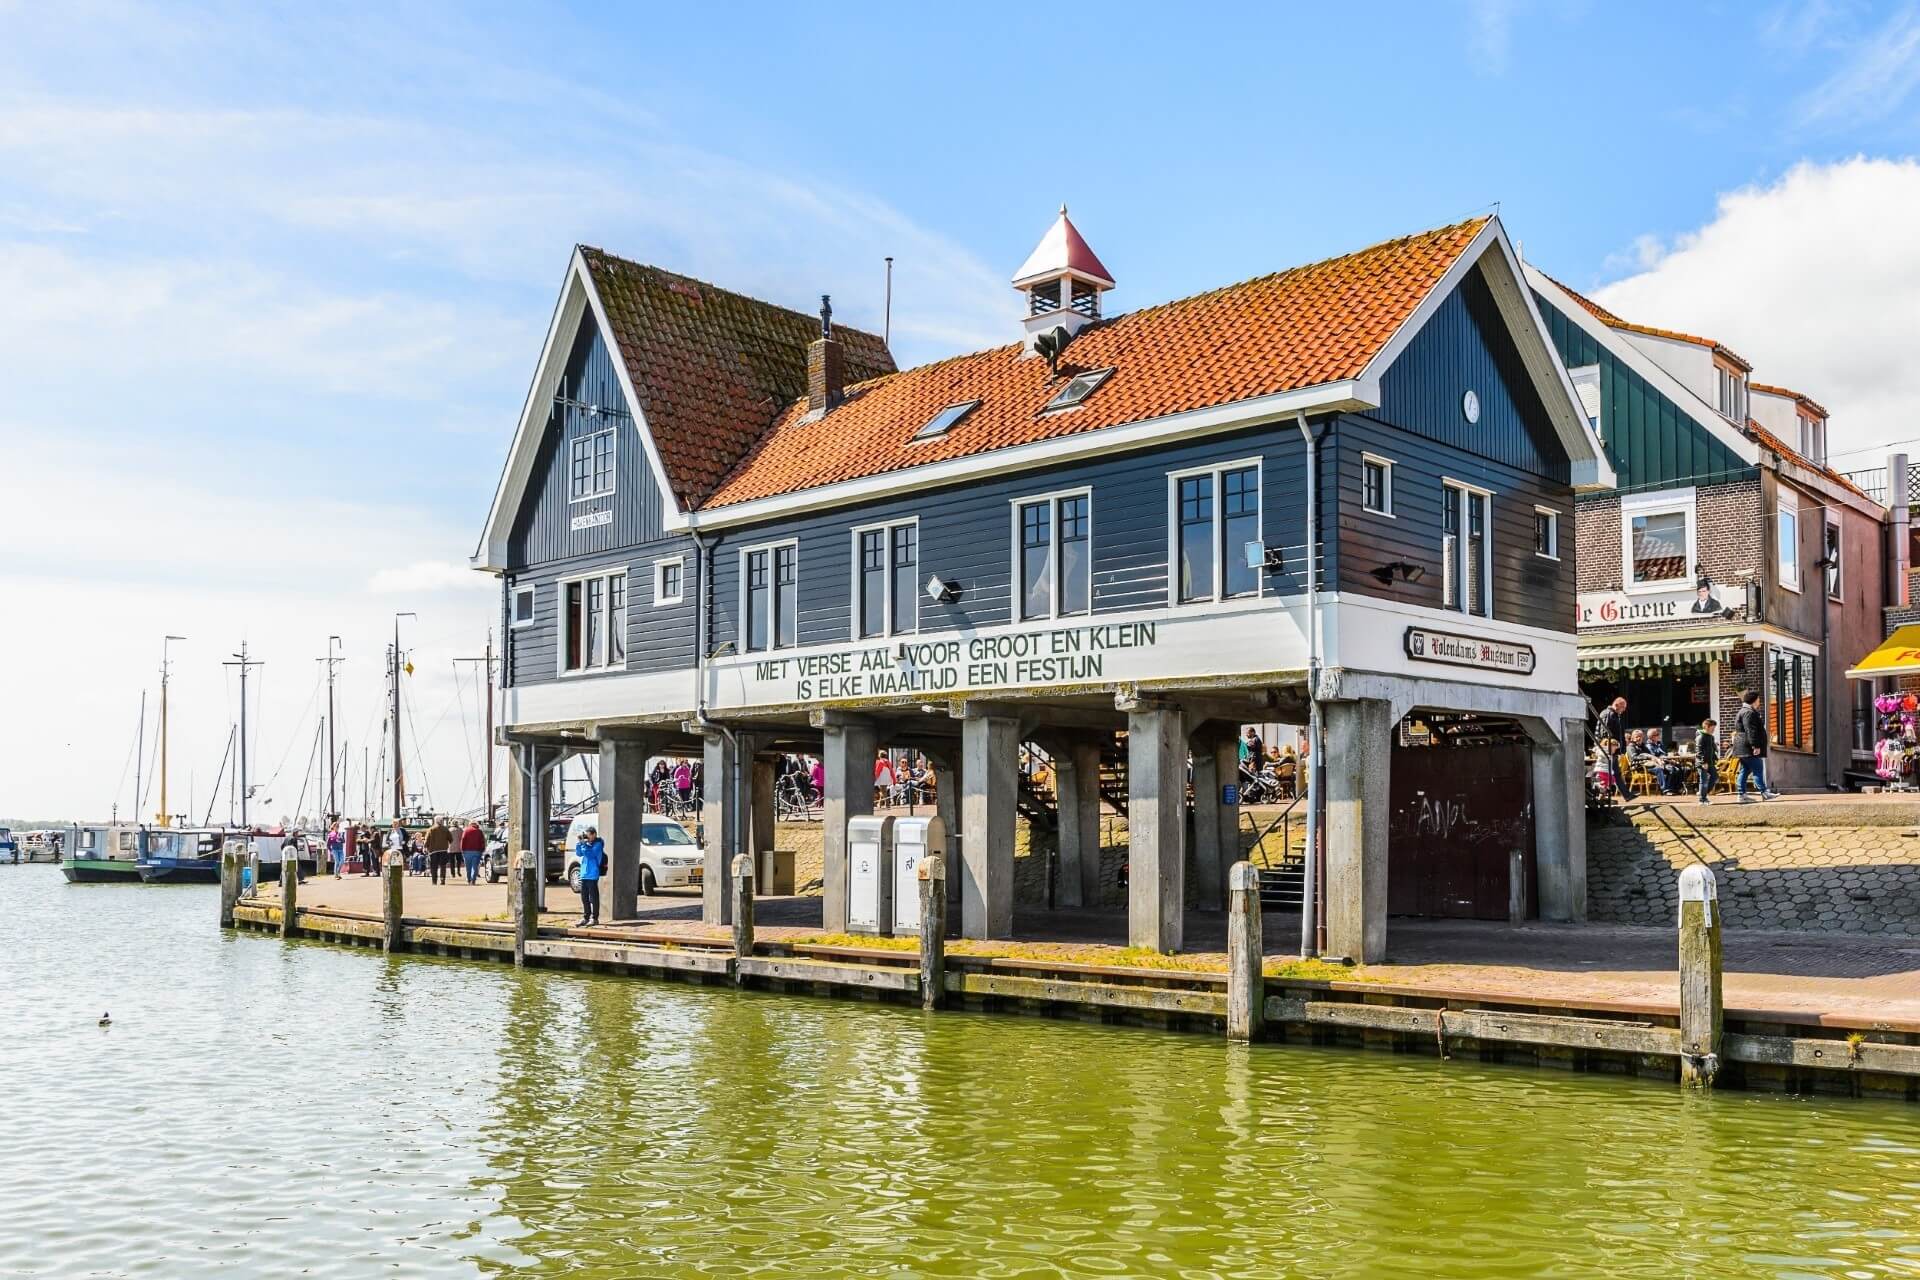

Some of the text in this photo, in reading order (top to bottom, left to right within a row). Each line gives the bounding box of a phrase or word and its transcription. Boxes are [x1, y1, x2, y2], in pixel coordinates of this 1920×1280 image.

[1600, 600, 1677, 622] Groene
[756, 622, 1156, 681] MET VERSE AAL VOOR GROOT EN KLEIN
[1432, 637, 1514, 666] Volendams Museum
[797, 654, 1102, 701] IS ELKE MAALTIJD EEN FESTIJN
